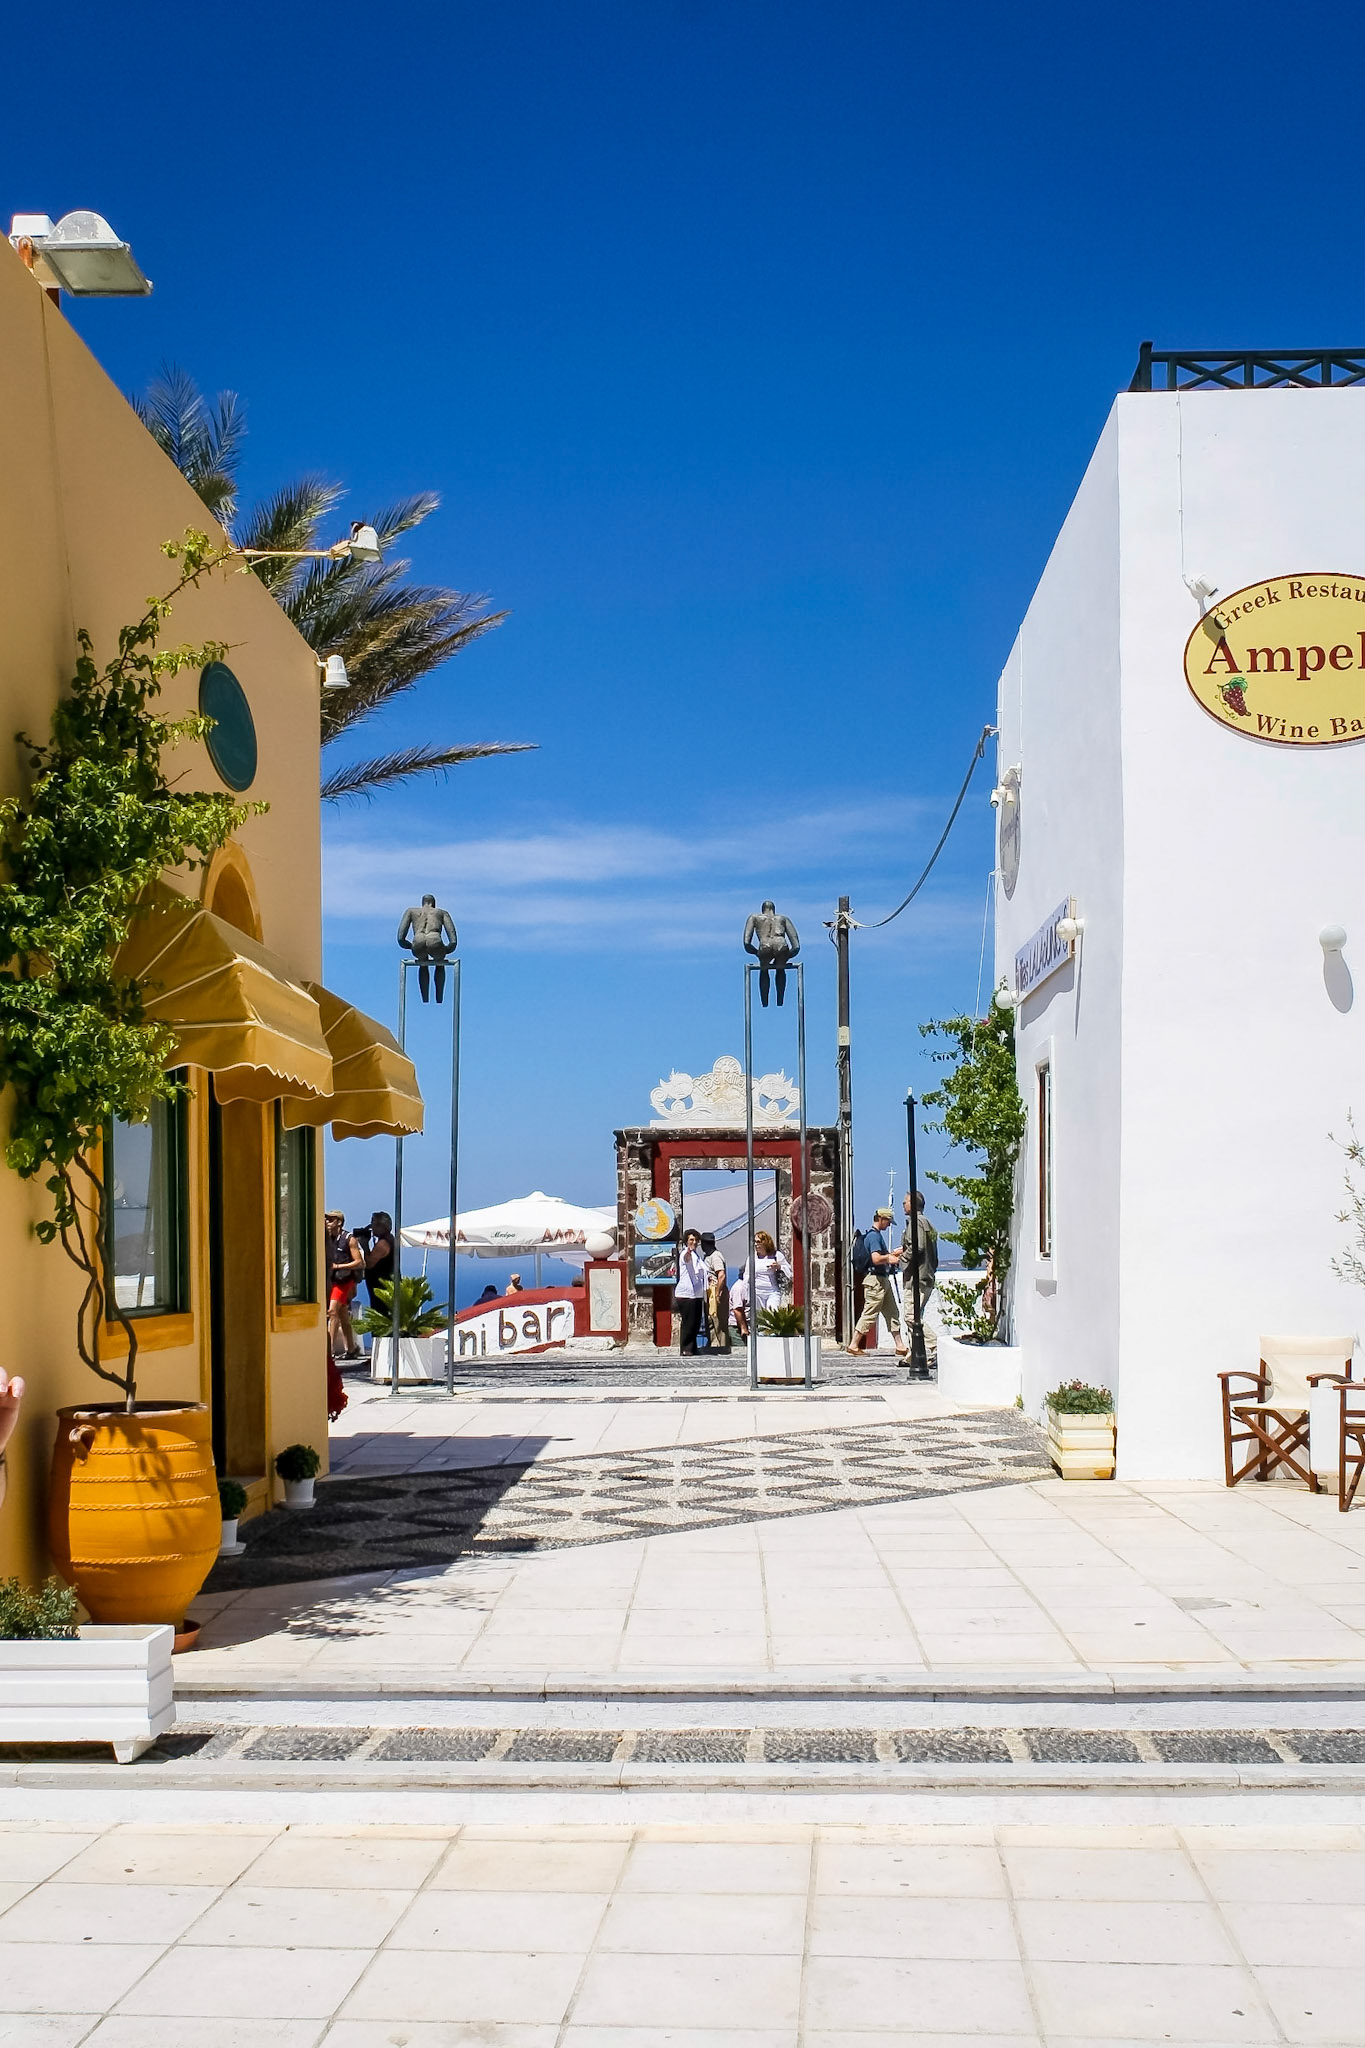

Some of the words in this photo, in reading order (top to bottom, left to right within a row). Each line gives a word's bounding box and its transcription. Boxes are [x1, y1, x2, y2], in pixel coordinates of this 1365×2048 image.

[1213, 587, 1282, 631] Greek
[1256, 713, 1319, 738] Wine
[1329, 716, 1365, 737] Ba
[446, 1323, 487, 1356] ni
[498, 1306, 565, 1351] bar
